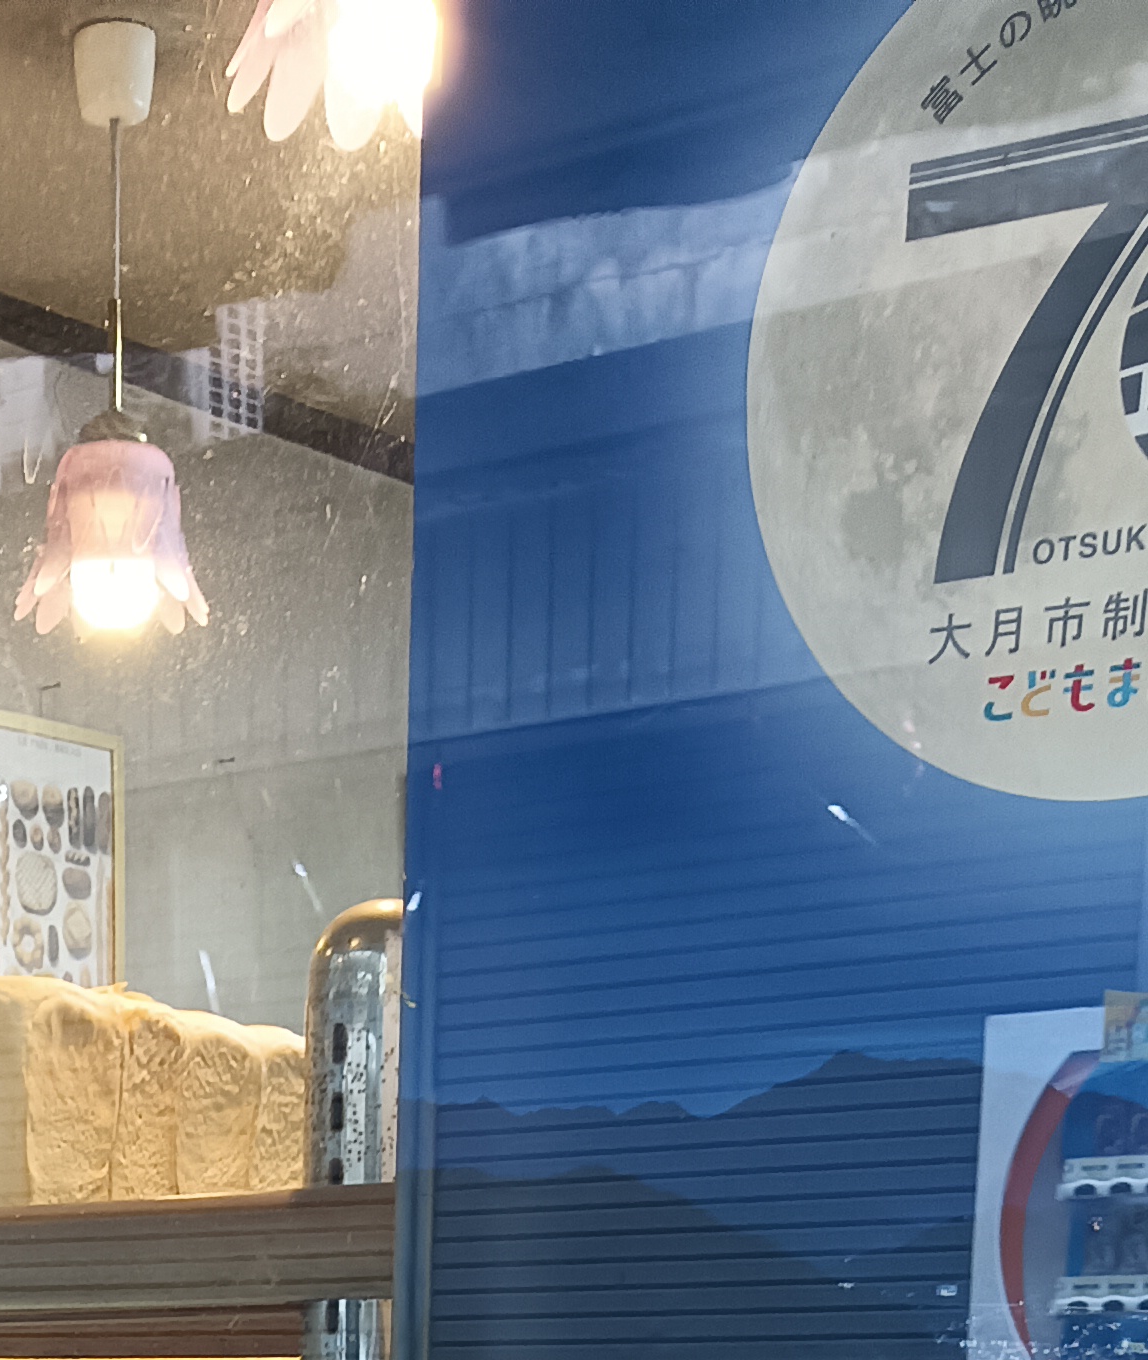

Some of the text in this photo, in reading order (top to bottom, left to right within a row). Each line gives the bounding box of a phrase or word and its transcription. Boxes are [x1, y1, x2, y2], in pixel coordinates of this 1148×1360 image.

[921, 0, 1078, 125] 富士の
[1033, 523, 1148, 565] OTSUK
[928, 588, 1148, 665] 大月市制
[984, 657, 1142, 721] こどもま
